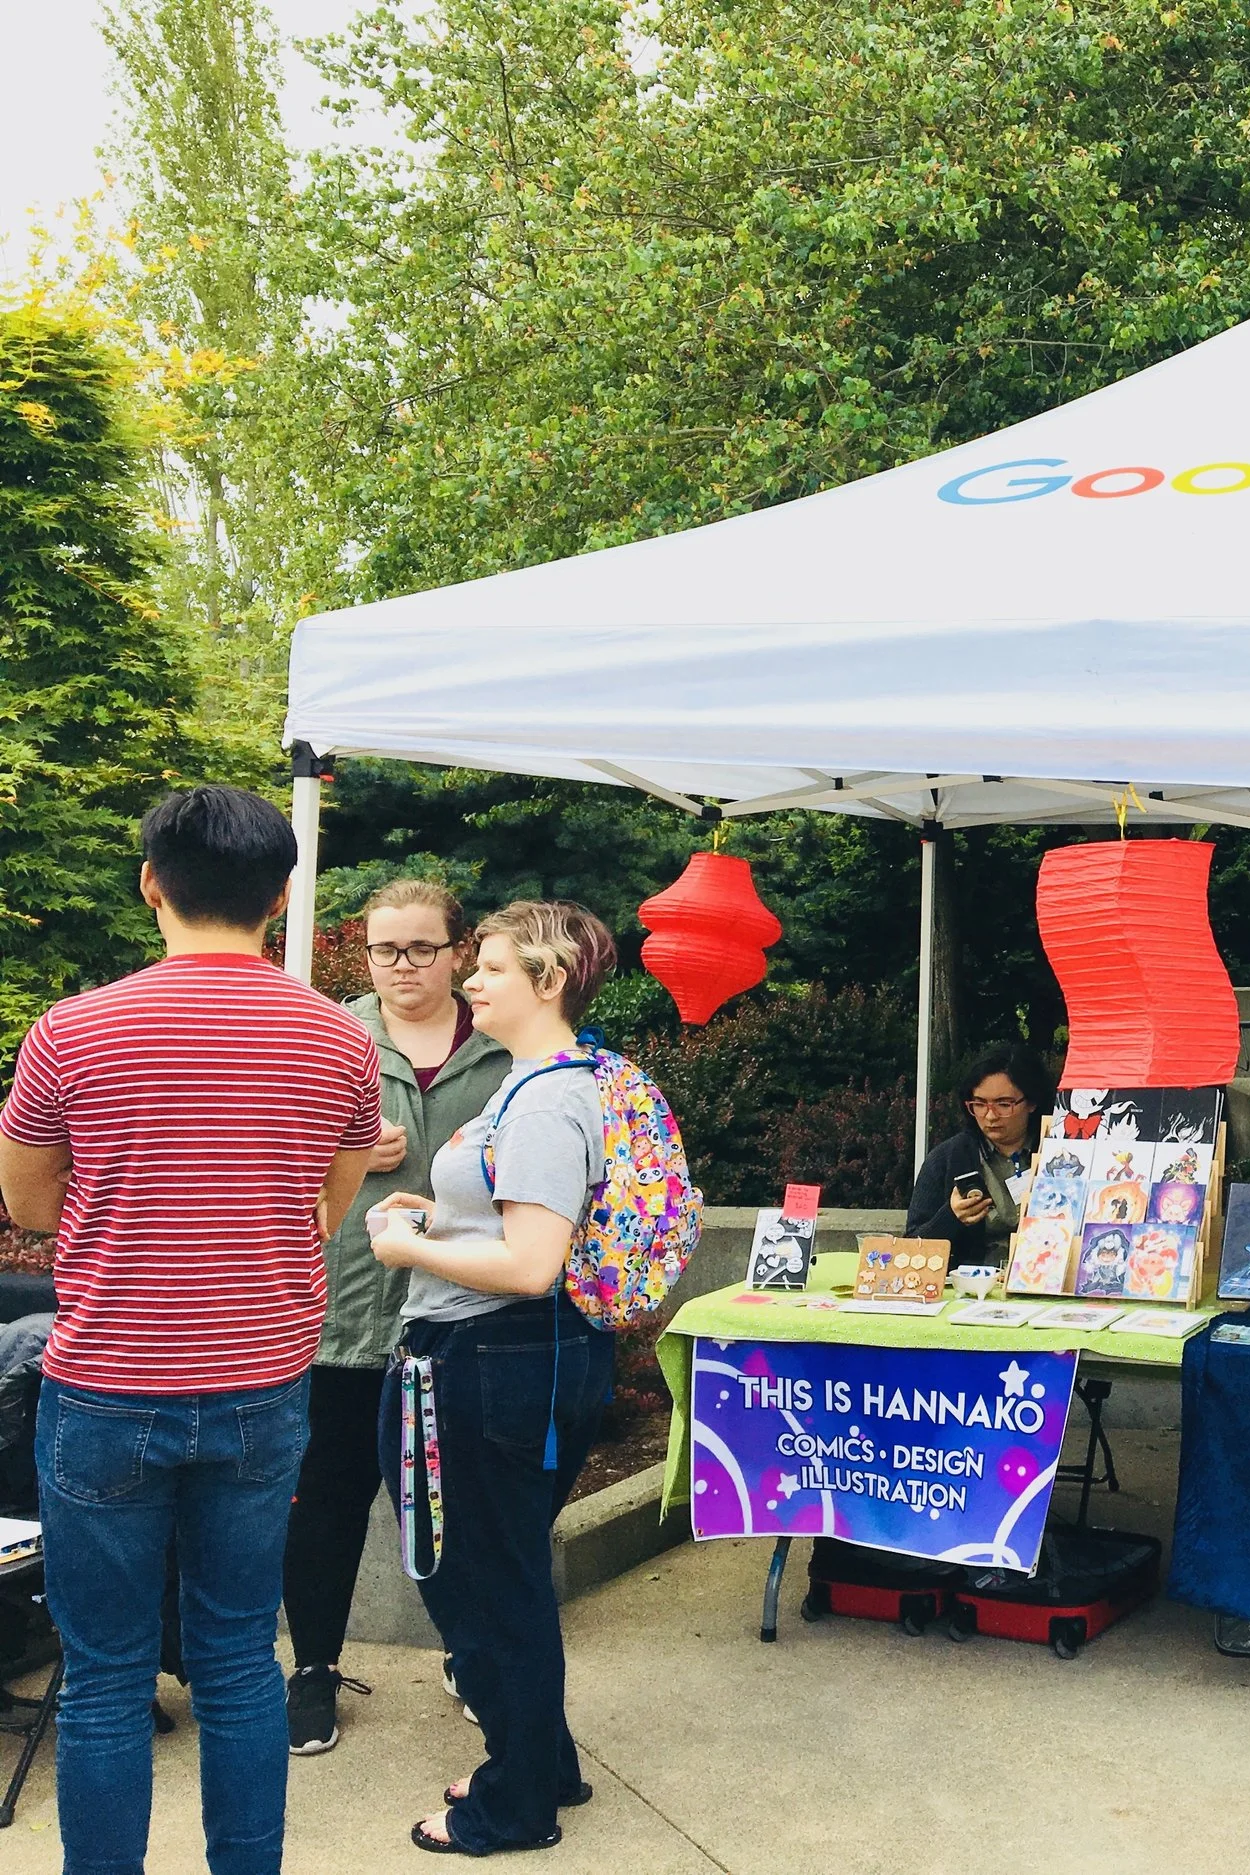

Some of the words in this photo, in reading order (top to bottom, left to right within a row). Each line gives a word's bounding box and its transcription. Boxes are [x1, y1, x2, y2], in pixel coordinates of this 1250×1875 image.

[738, 1376, 813, 1411] THIS
[825, 1380, 851, 1413] IS
[863, 1383, 1045, 1434] HANNAKO
[777, 1433, 875, 1463] COMICS
[893, 1444, 984, 1479] DESIGN
[801, 1465, 966, 1512] ILLUSTRATION
